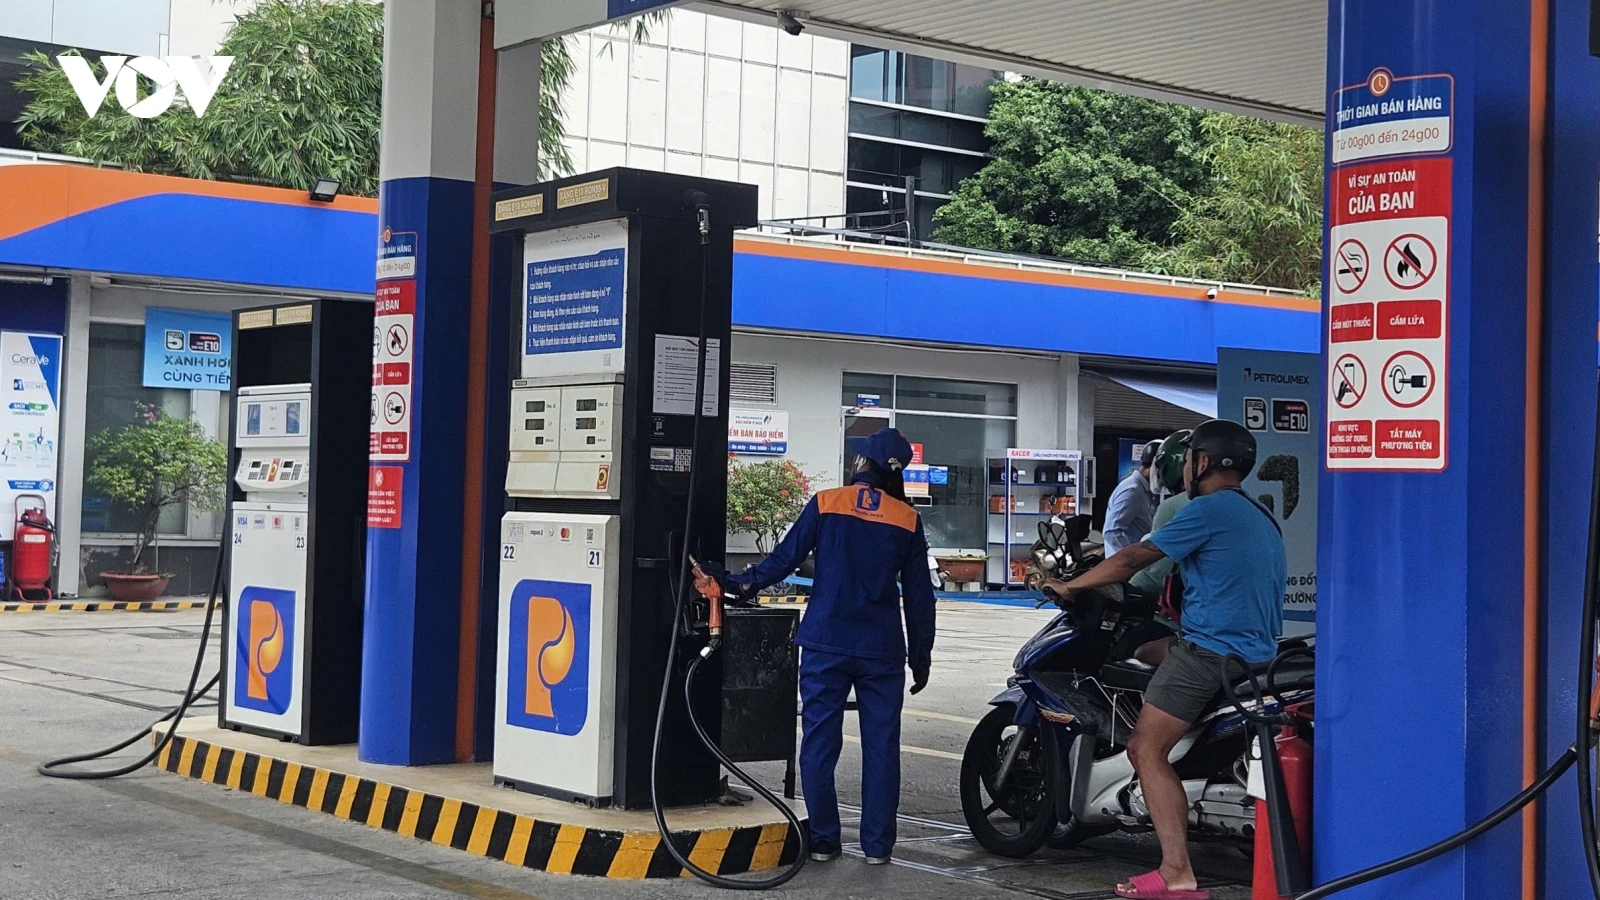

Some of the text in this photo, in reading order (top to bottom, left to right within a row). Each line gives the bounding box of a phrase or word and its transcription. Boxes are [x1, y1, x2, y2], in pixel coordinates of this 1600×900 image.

[1356, 104, 1378, 119] GIAN
[1381, 98, 1404, 115] BÁN
[1407, 96, 1442, 112] HÀNG
[1348, 134, 1375, 149] 00g00
[1378, 129, 1398, 144] đến
[1402, 128, 1439, 143] 24g00
[1348, 168, 1415, 188] VÌ SỰ AN TOÀN
[1349, 190, 1414, 215] CỦA BẠN
[397, 244, 412, 253] HÀNG
[386, 299, 400, 312] BẠN
[1342, 318, 1352, 328] HÚT
[1353, 316, 1371, 327] THUỐC
[1390, 314, 1425, 326] CẤM LỬA
[167, 336, 218, 351] 5 E10
[12, 354, 49, 365] CeraVe
[164, 355, 203, 367] XANH
[163, 369, 202, 382] CÙNG
[1254, 373, 1309, 384] PETROLIMEX
[1247, 406, 1265, 428] 5
[1290, 413, 1307, 430] E10
[729, 426, 784, 438] ỂM BÁN BẢO HIỂM
[1389, 427, 1422, 438] TẮT MÁY
[1381, 440, 1432, 450] PHƯƠNG TIỆN
[237, 517, 247, 525] VISA
[234, 533, 242, 544] 24
[296, 536, 304, 548] 23
[504, 546, 514, 559] 22
[589, 551, 600, 565] 21
[1284, 590, 1316, 603] RƯỜNG
